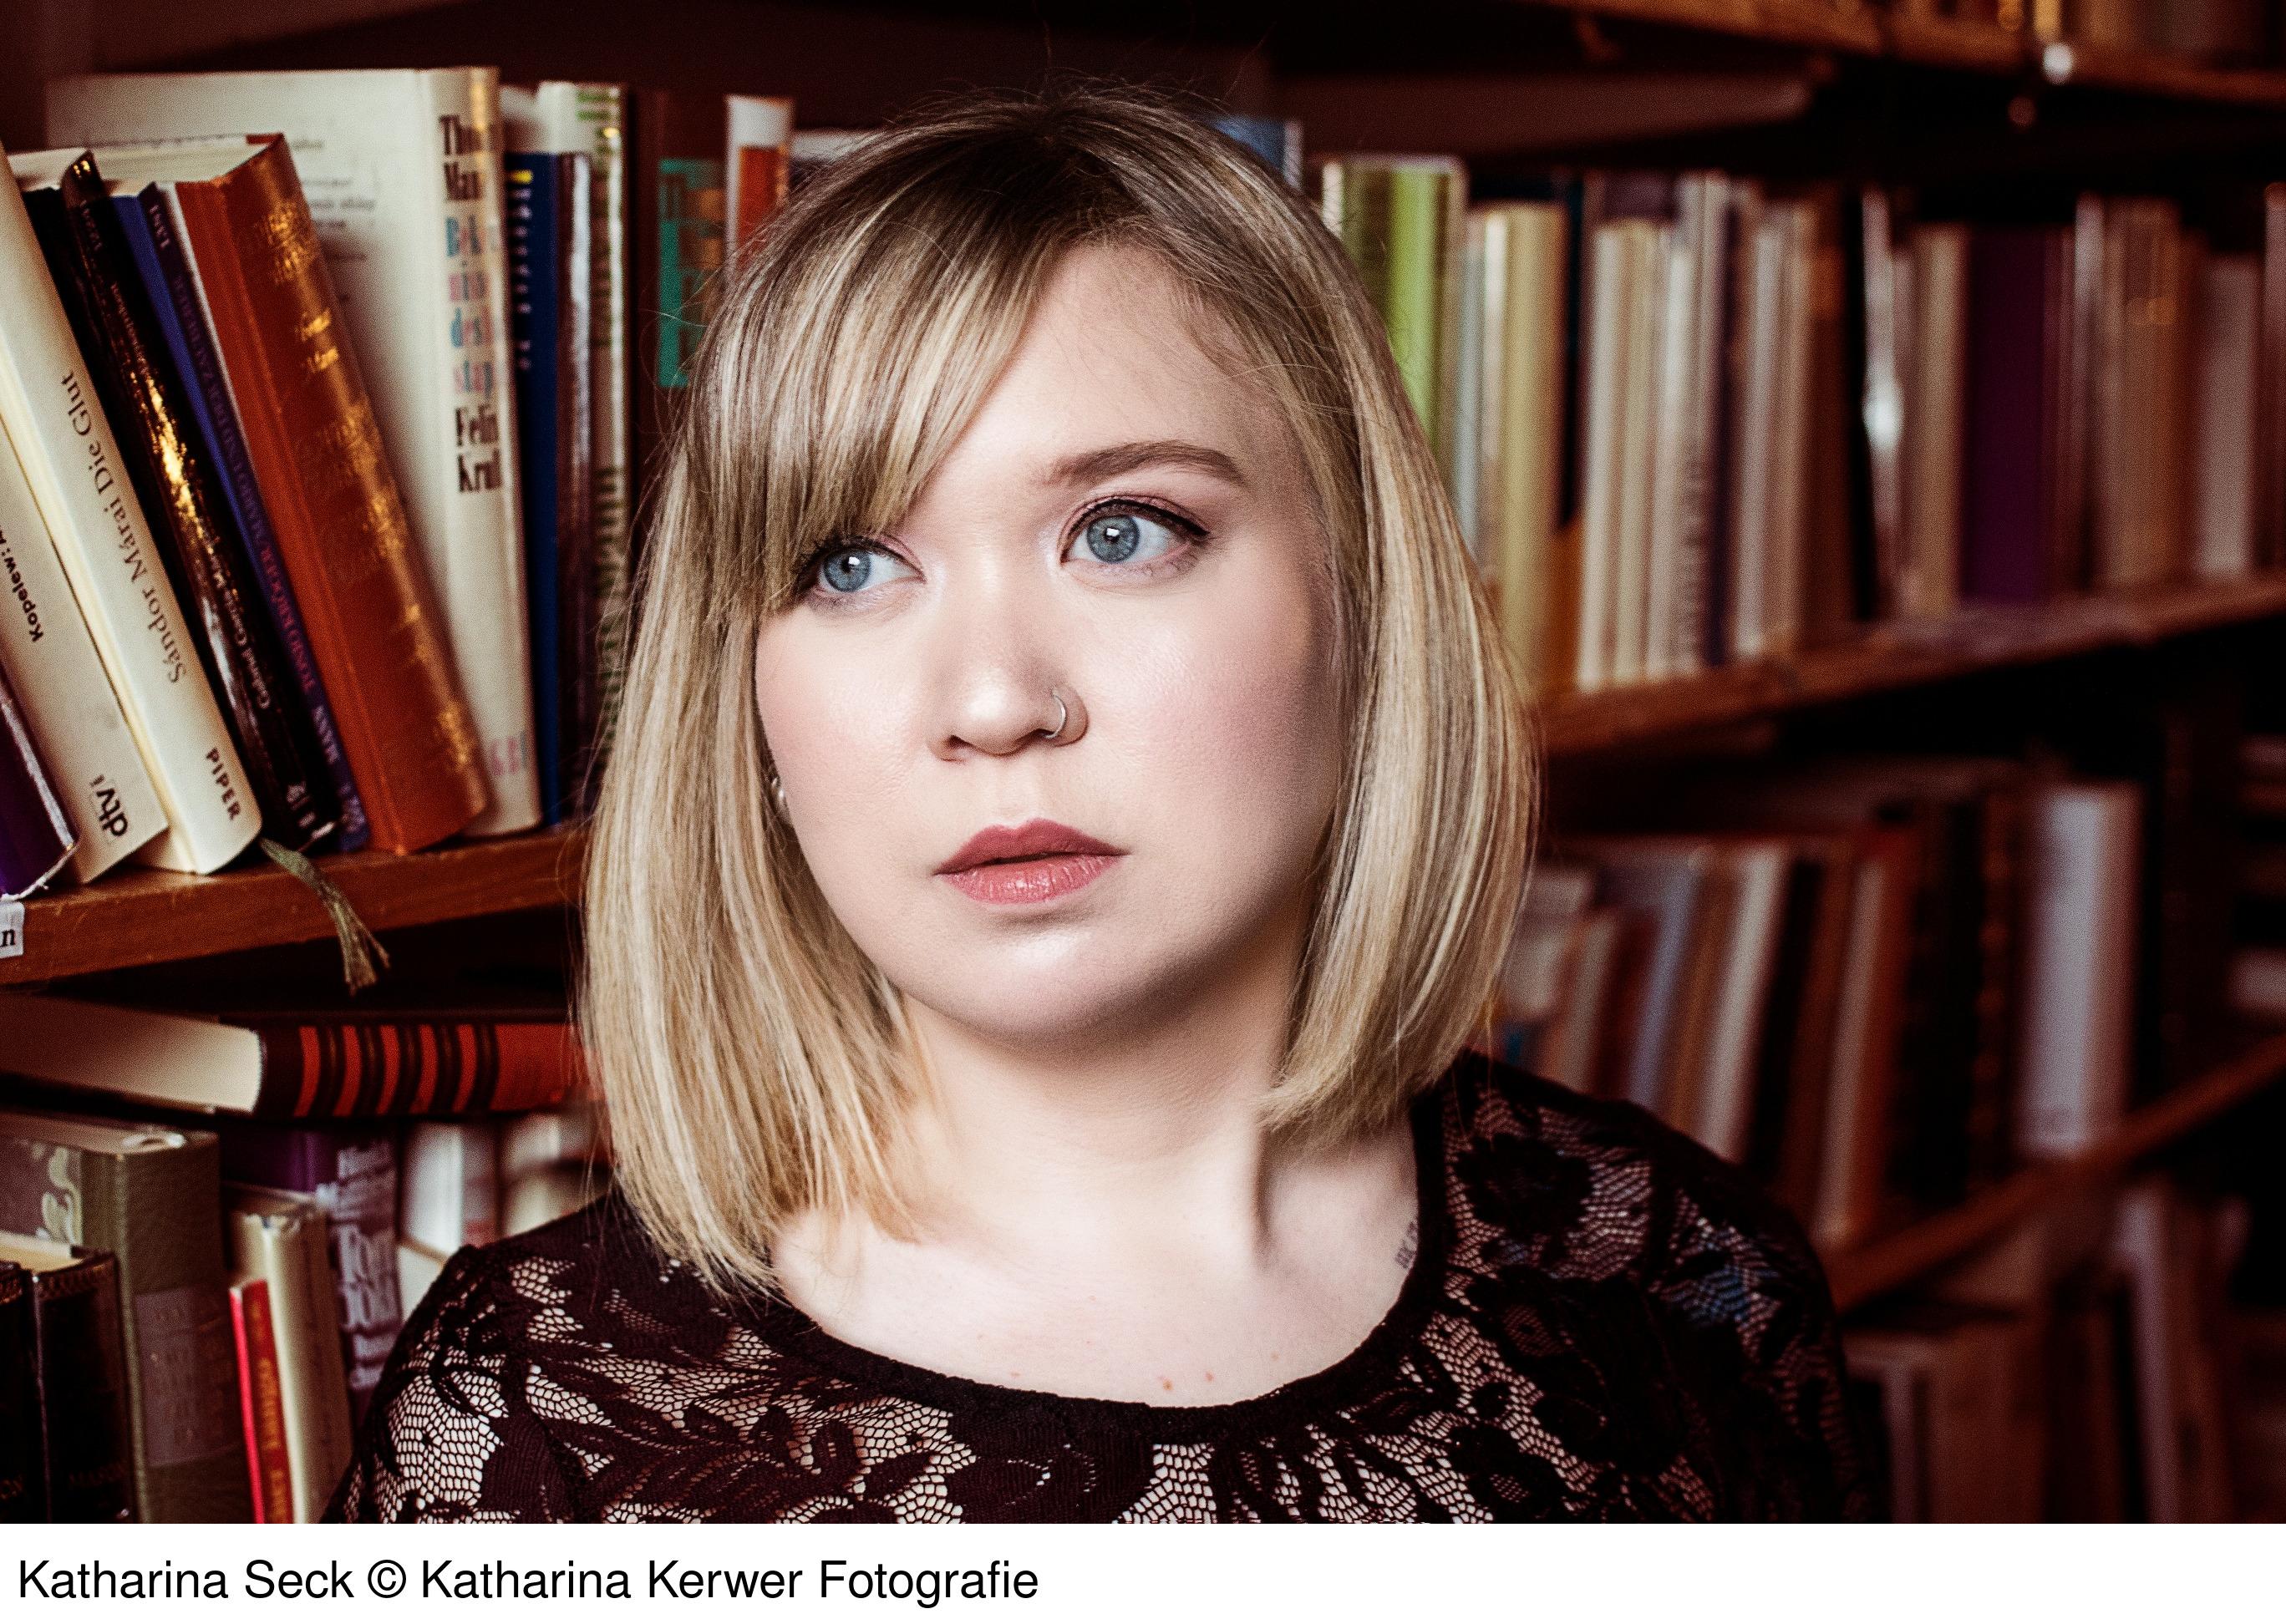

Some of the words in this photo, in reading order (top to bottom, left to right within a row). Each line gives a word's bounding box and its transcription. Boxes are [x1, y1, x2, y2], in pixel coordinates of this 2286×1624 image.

[61, 371, 92, 436] Glut
[89, 439, 114, 495] Die
[104, 497, 148, 583] Márai
[1, 547, 43, 642] Kopelew:
[142, 586, 187, 683] Sándor
[96, 788, 129, 836] dtv
[206, 746, 241, 820] PIPER
